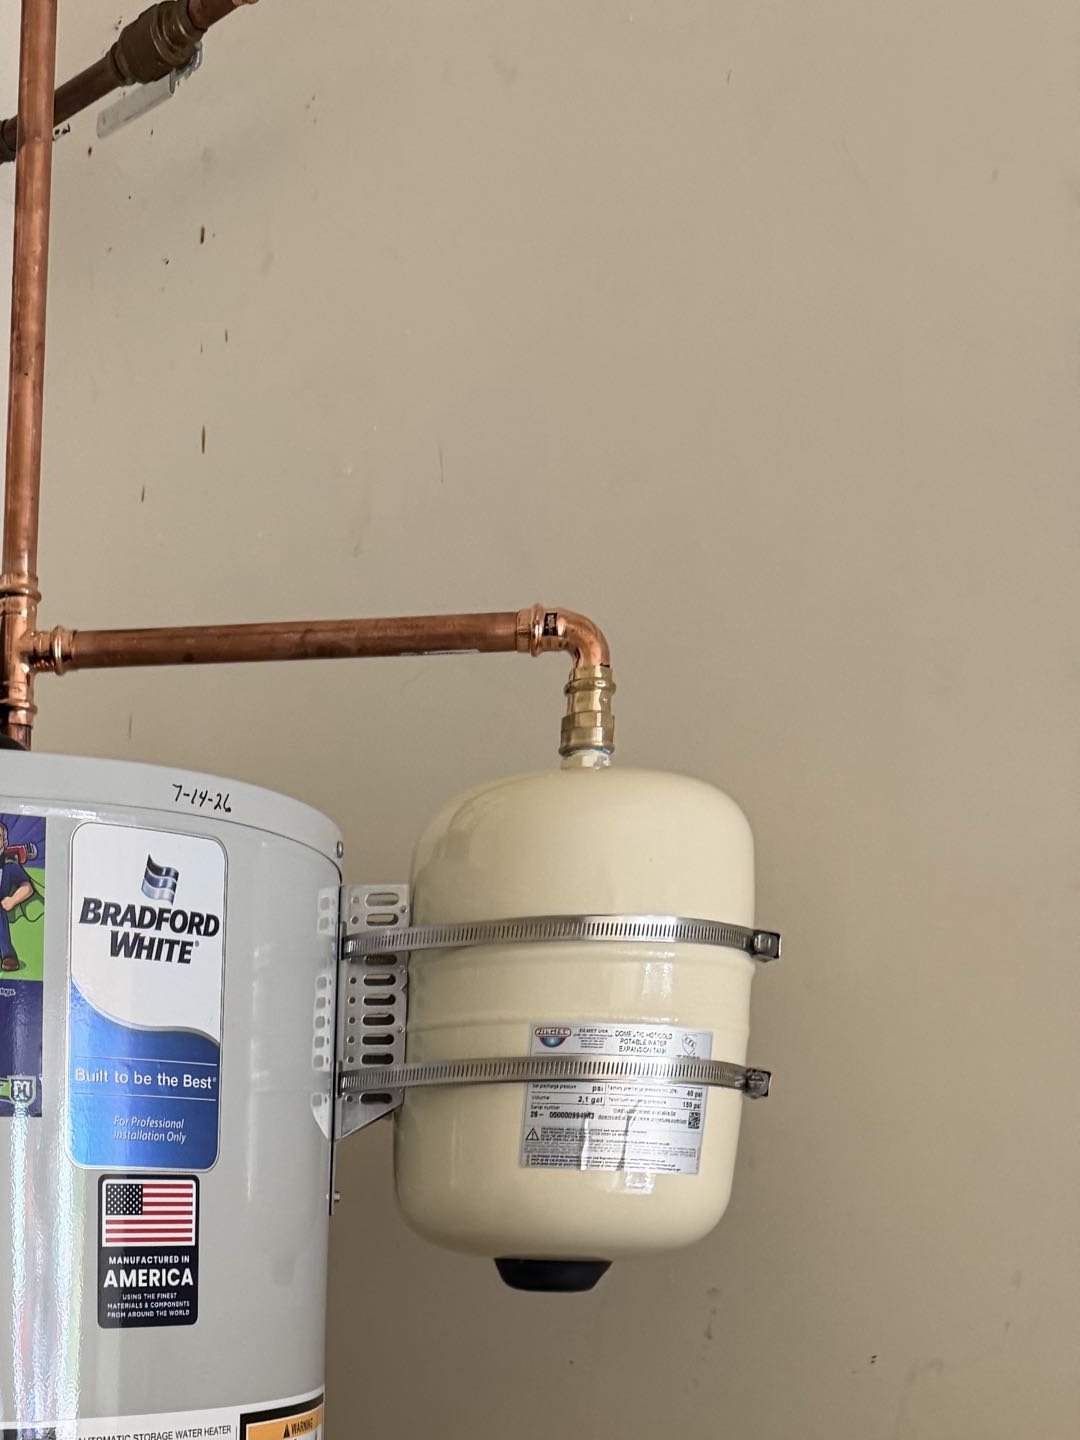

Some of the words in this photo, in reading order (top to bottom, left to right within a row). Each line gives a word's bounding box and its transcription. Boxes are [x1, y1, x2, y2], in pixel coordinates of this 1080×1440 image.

[172, 783, 232, 813] 7-14-26
[78, 896, 221, 938] BRADFORD
[75, 1068, 109, 1083] Built
[114, 1070, 129, 1084] to
[133, 1071, 152, 1085] be
[157, 1072, 179, 1087] the
[113, 1115, 129, 1126] For
[131, 1116, 185, 1130] Professional
[113, 1130, 165, 1142] Installation
[166, 1131, 187, 1145] Only
[108, 1255, 180, 1265] MANUFACTURED
[181, 1255, 190, 1264] IN
[103, 1267, 194, 1288] AMERICA
[143, 1292, 156, 1300] THE
[156, 1292, 177, 1300] FINEST
[149, 1300, 190, 1308] COMPONENTS
[107, 1311, 126, 1319] FROM
[127, 1310, 155, 1318] AROUND
[175, 1428, 203, 1440] WATER
[203, 1424, 232, 1437] HEATER
